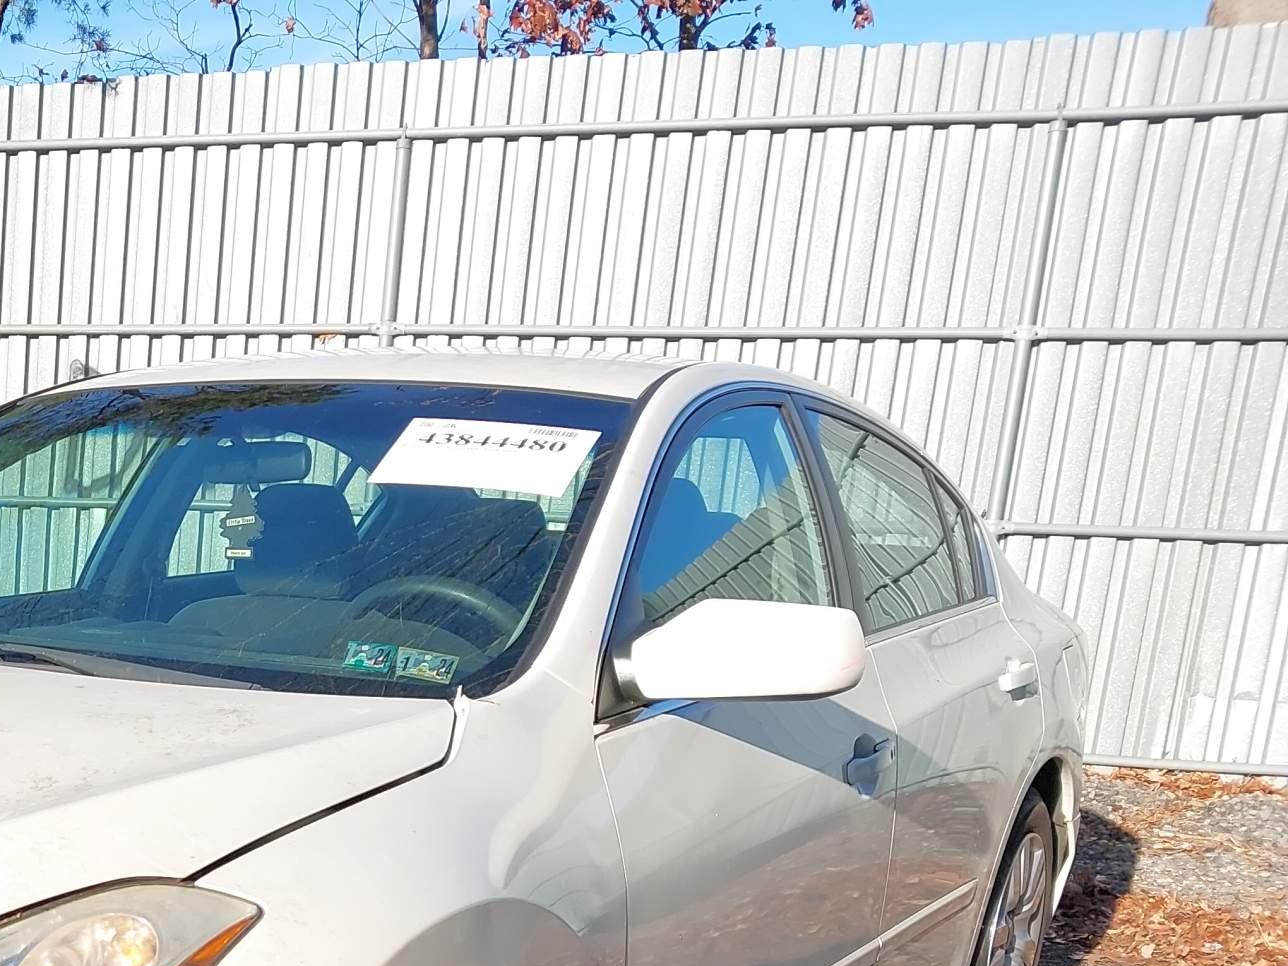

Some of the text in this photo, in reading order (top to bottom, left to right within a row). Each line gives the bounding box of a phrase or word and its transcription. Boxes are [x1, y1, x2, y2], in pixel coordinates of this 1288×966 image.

[418, 432, 567, 453] 43844480
[372, 648, 392, 667] 24
[435, 658, 455, 679] 24
